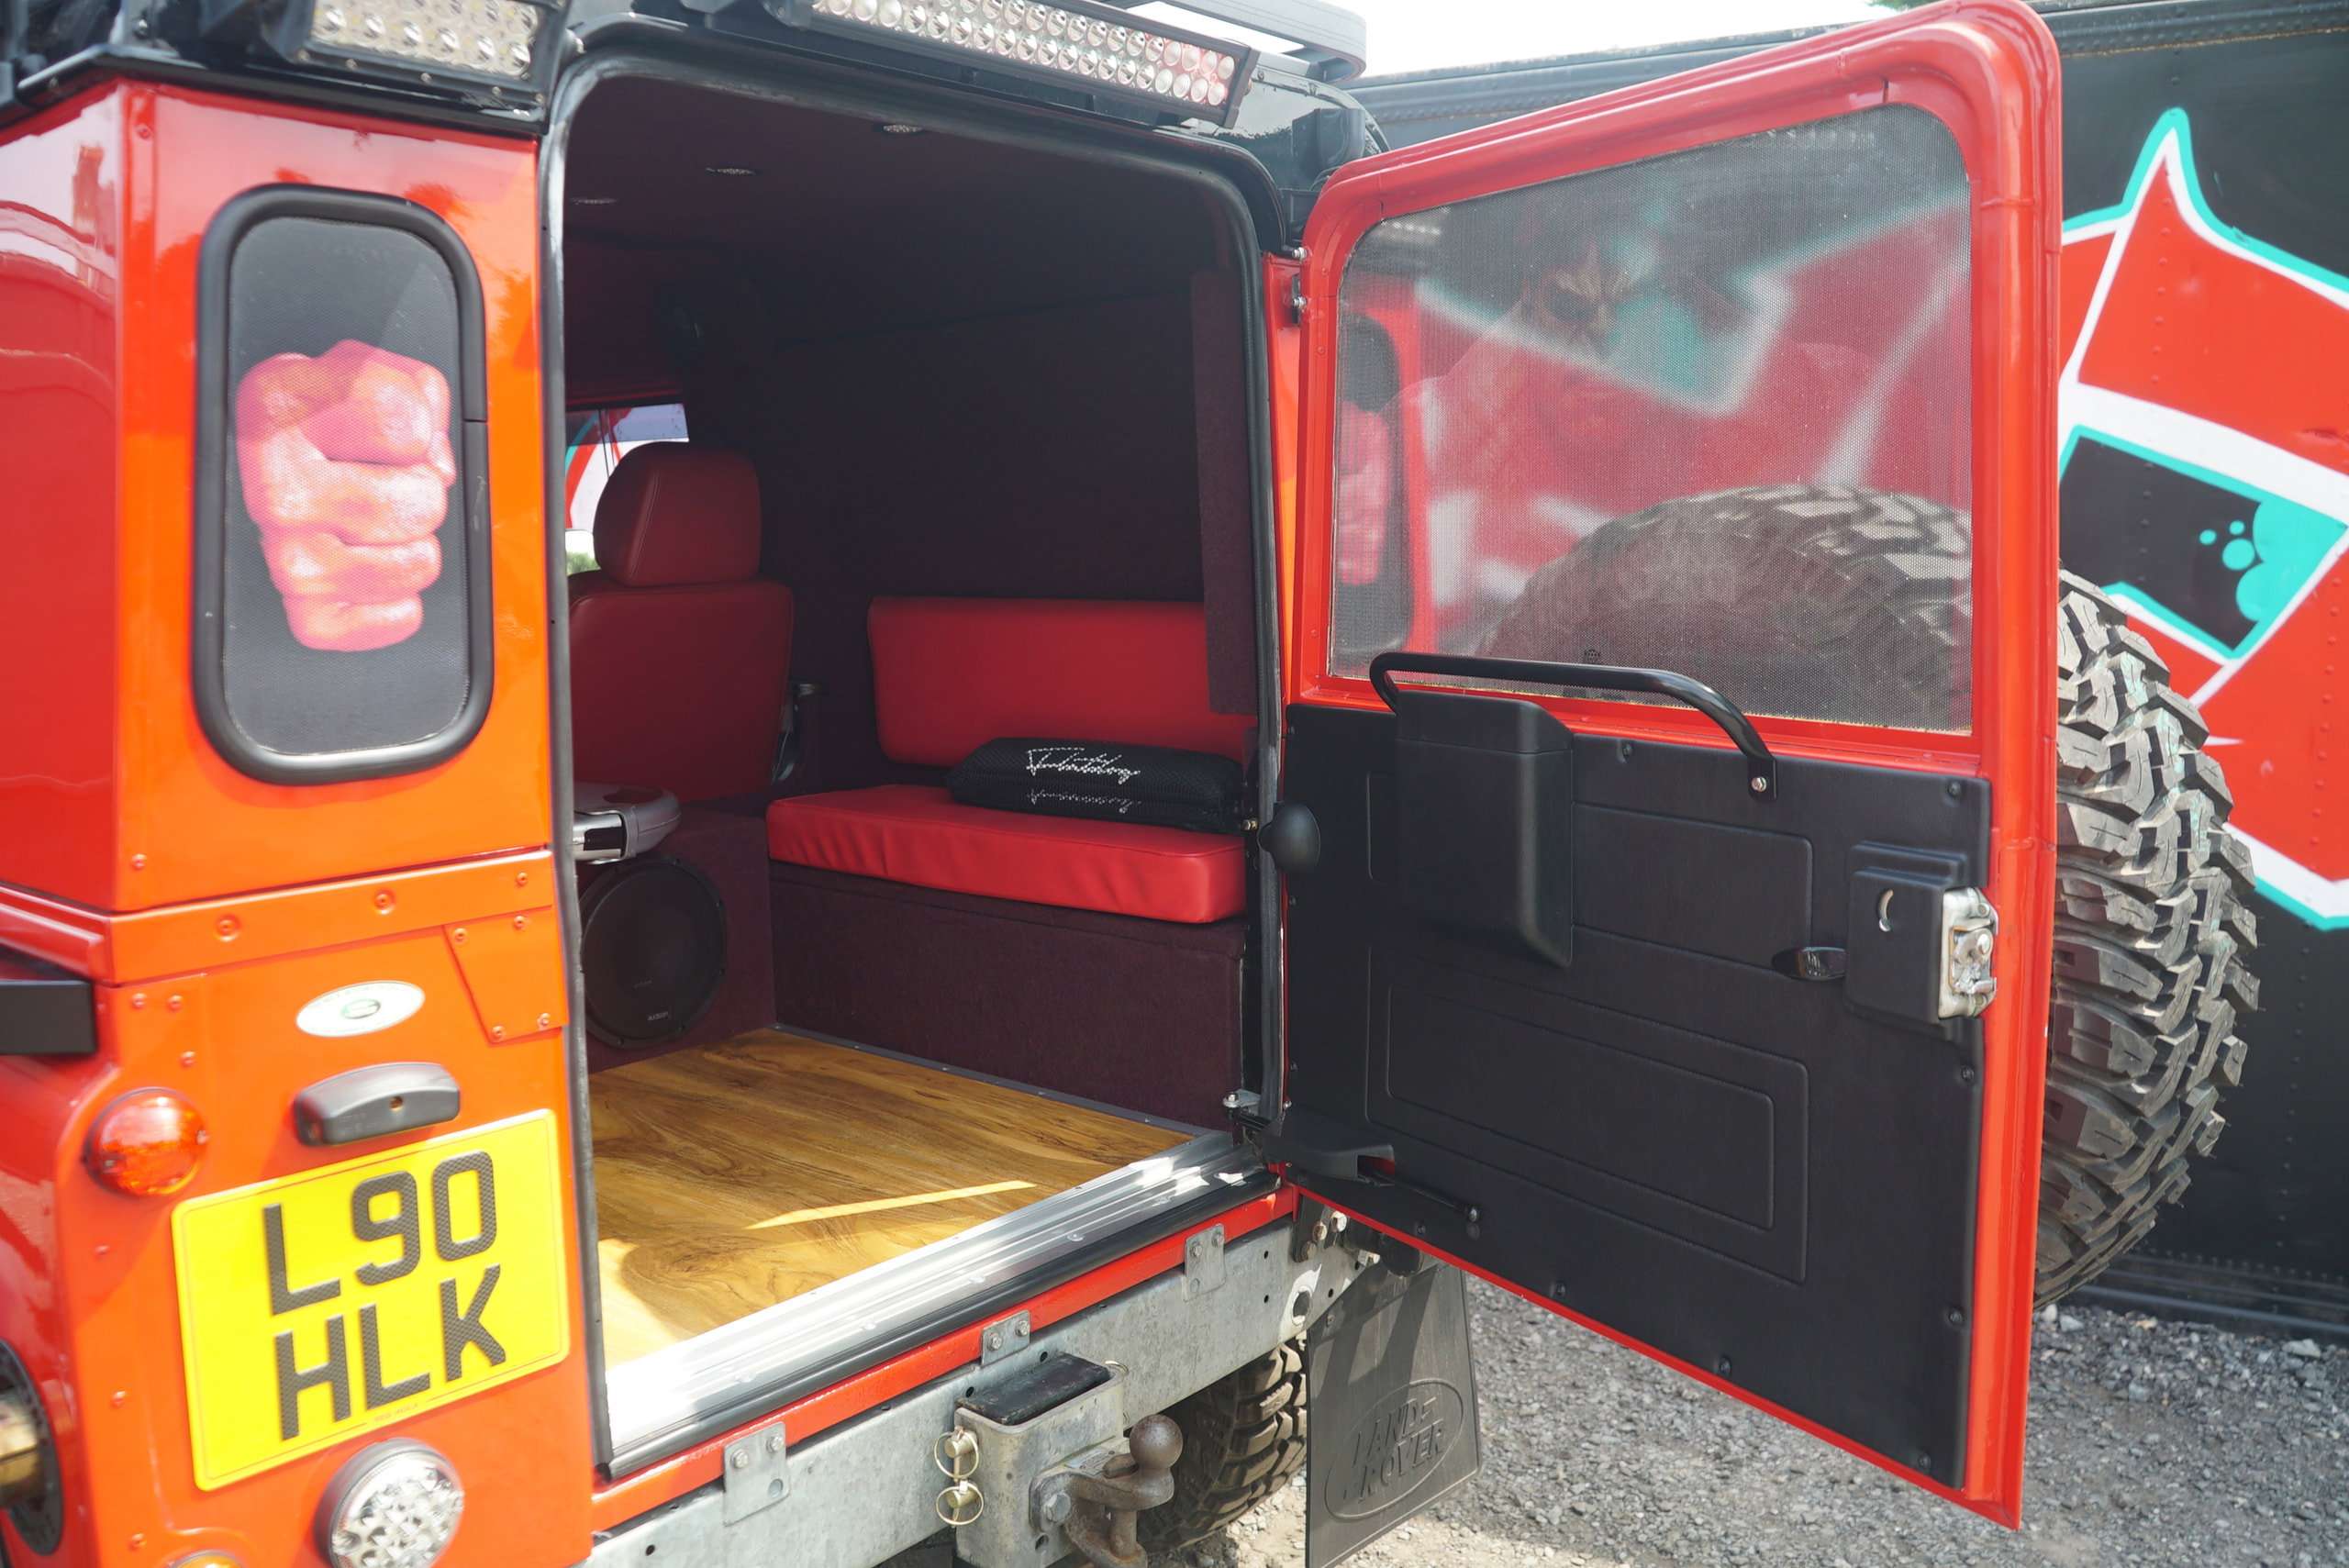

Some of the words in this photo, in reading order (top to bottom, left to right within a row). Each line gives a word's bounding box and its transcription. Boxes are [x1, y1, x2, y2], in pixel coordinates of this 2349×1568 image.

[262, 1150, 497, 1317] L90
[273, 1262, 507, 1442] HLK
[1358, 1418, 1443, 1504] ROVER
